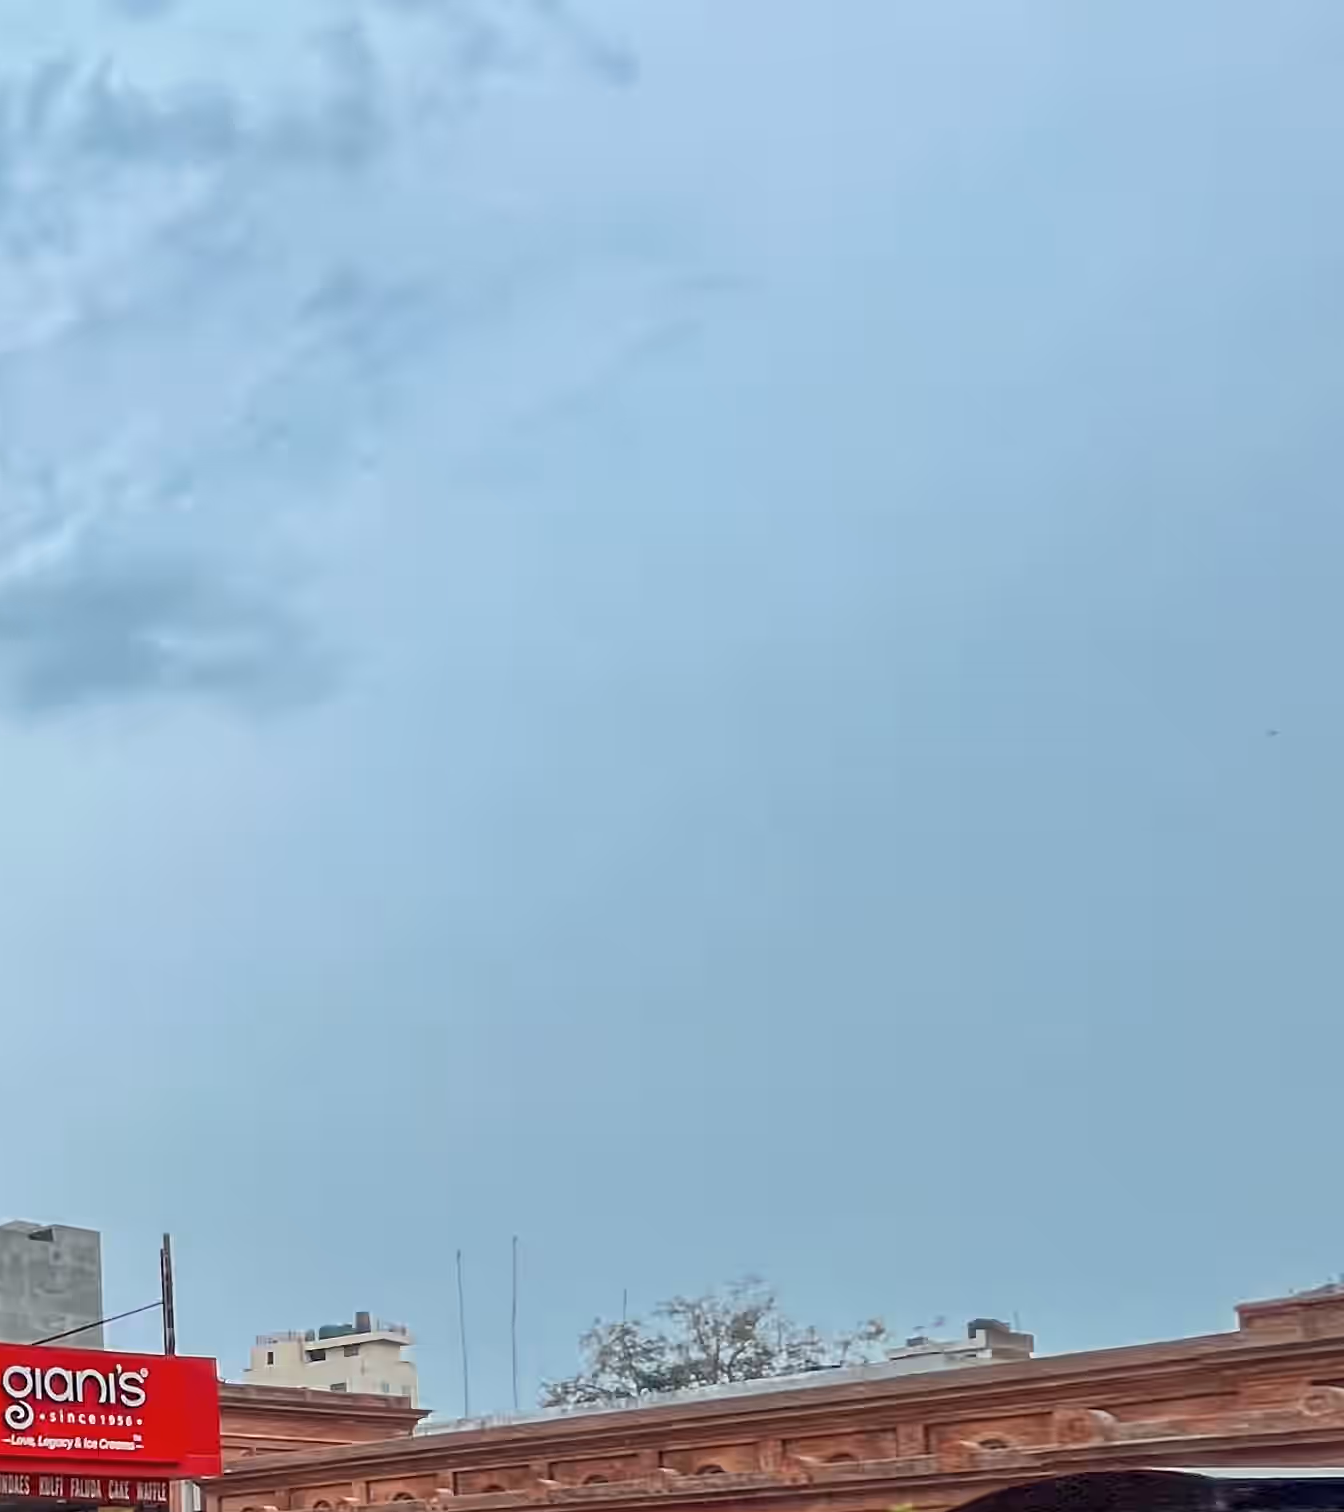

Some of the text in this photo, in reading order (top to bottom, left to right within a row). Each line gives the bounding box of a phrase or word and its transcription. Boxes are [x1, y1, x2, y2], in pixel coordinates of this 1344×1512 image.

[49, 1409, 96, 1425] since
[84, 1437, 98, 1449] Ice
[108, 1480, 130, 1500] CAKE
[136, 1481, 168, 1502] WAFFLE
